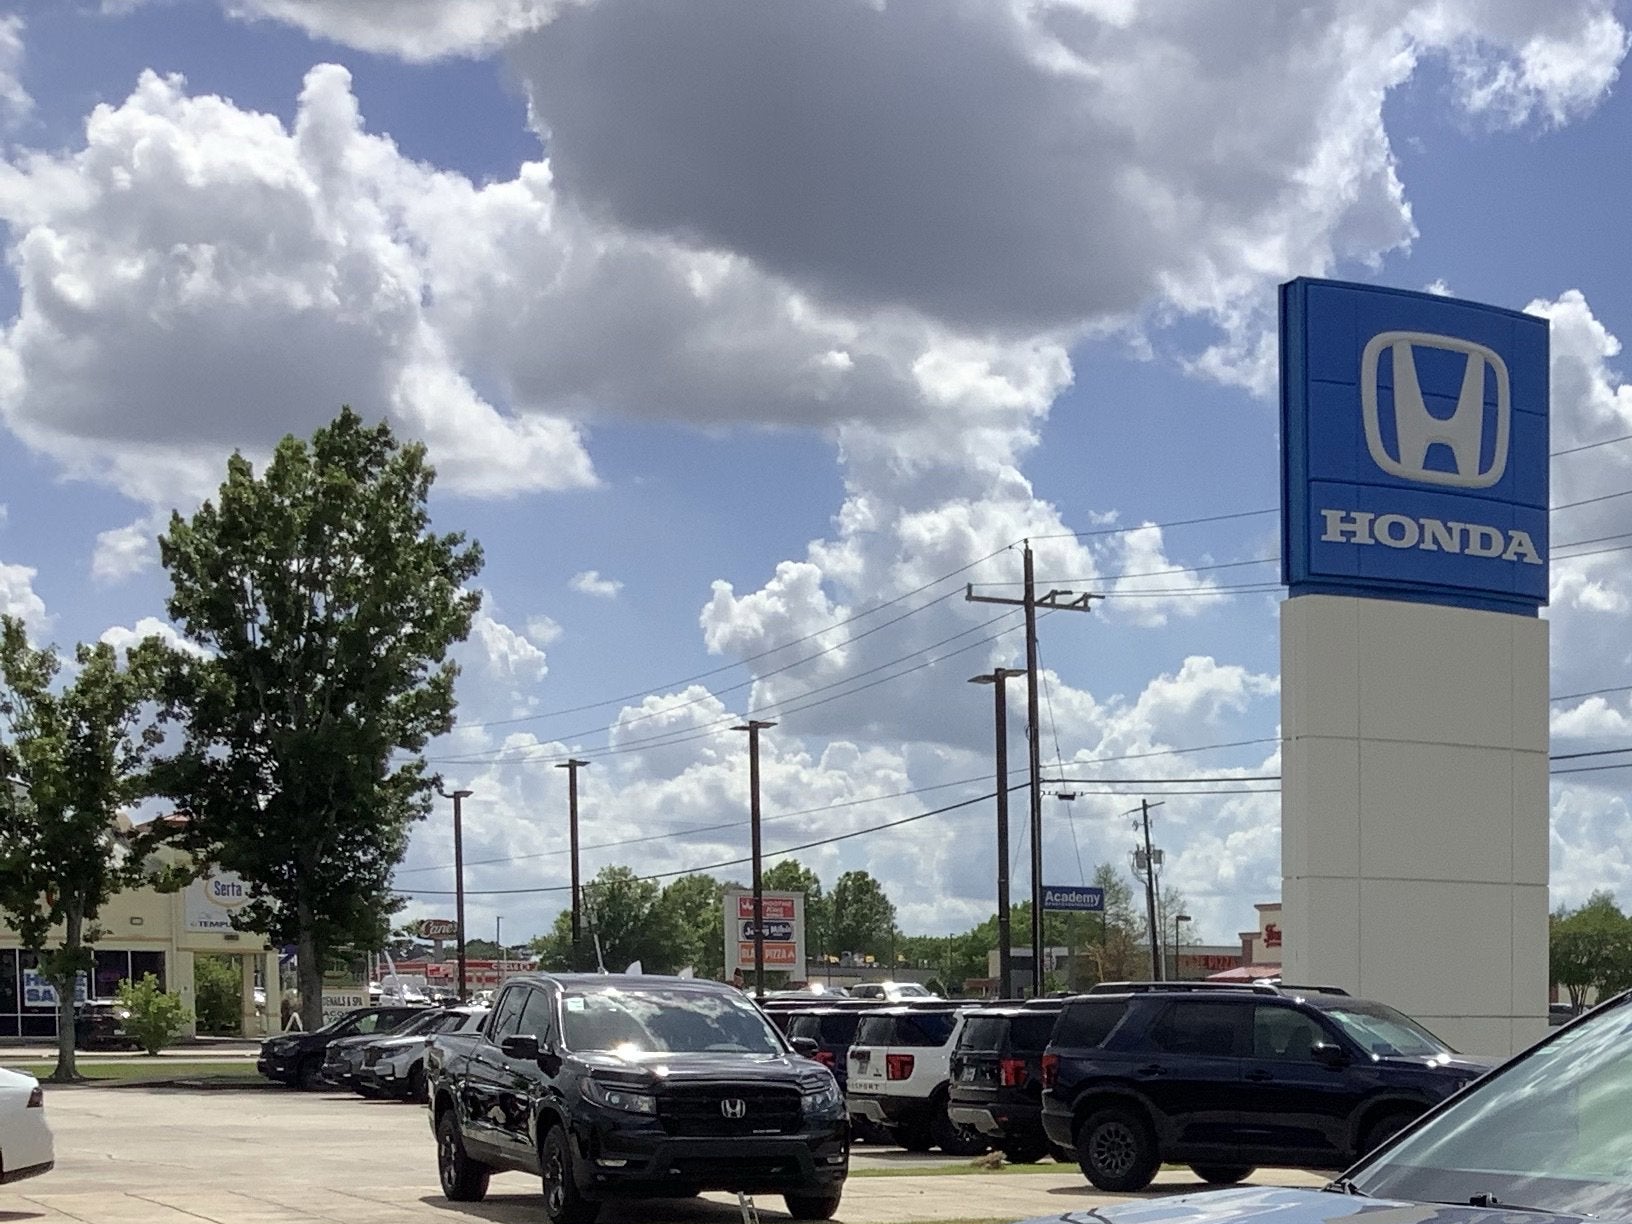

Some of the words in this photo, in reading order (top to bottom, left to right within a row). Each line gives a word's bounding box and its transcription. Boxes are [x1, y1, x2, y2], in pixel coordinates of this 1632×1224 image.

[1320, 508, 1543, 565] HONDA
[214, 881, 242, 897] Serta
[1044, 890, 1101, 907] Academy
